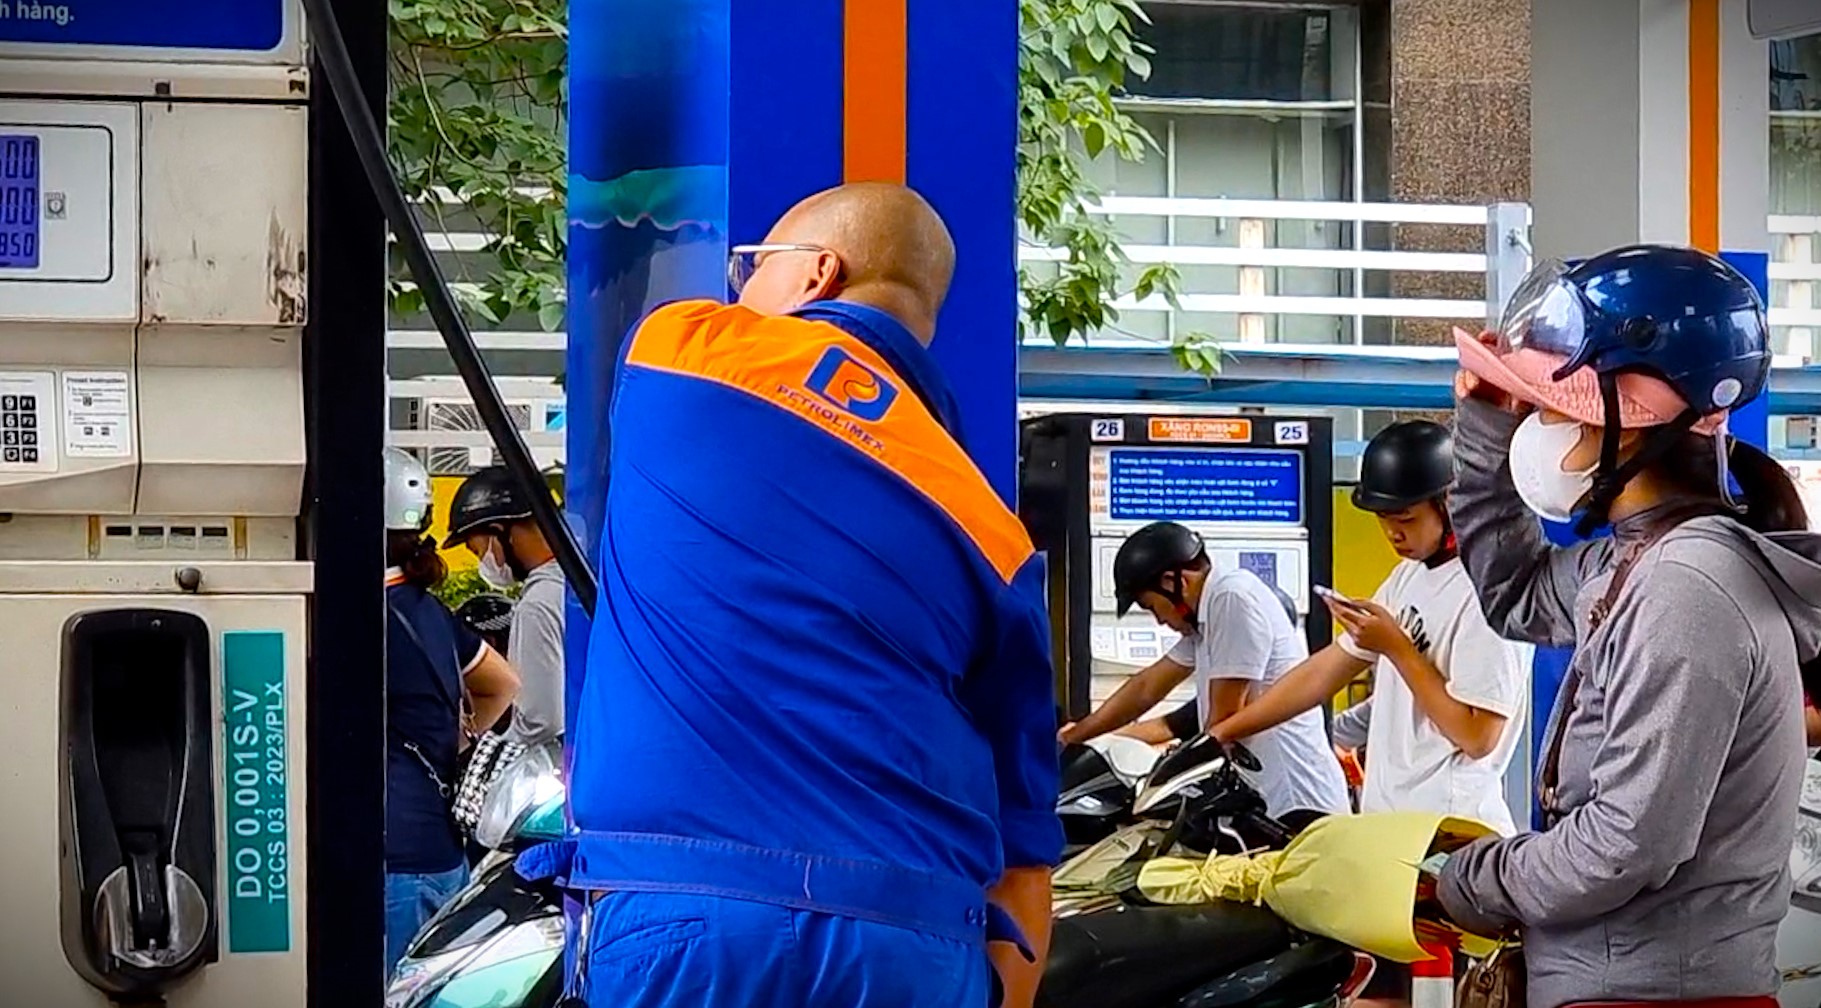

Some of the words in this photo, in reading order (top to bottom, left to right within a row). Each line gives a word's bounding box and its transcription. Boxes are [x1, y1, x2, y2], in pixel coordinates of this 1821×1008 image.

[17, 0, 75, 26] hàng.
[6, 415, 15, 427] 6
[777, 384, 885, 452] PETROLIMEX
[1097, 422, 1118, 436] 26
[7, 432, 16, 444] 3
[1281, 426, 1302, 439] 25
[265, 681, 284, 786] 2023/PLX
[233, 689, 265, 837] 0,001S-V
[267, 808, 285, 833] 03
[236, 848, 262, 899] DO
[268, 841, 286, 903] TCCS
